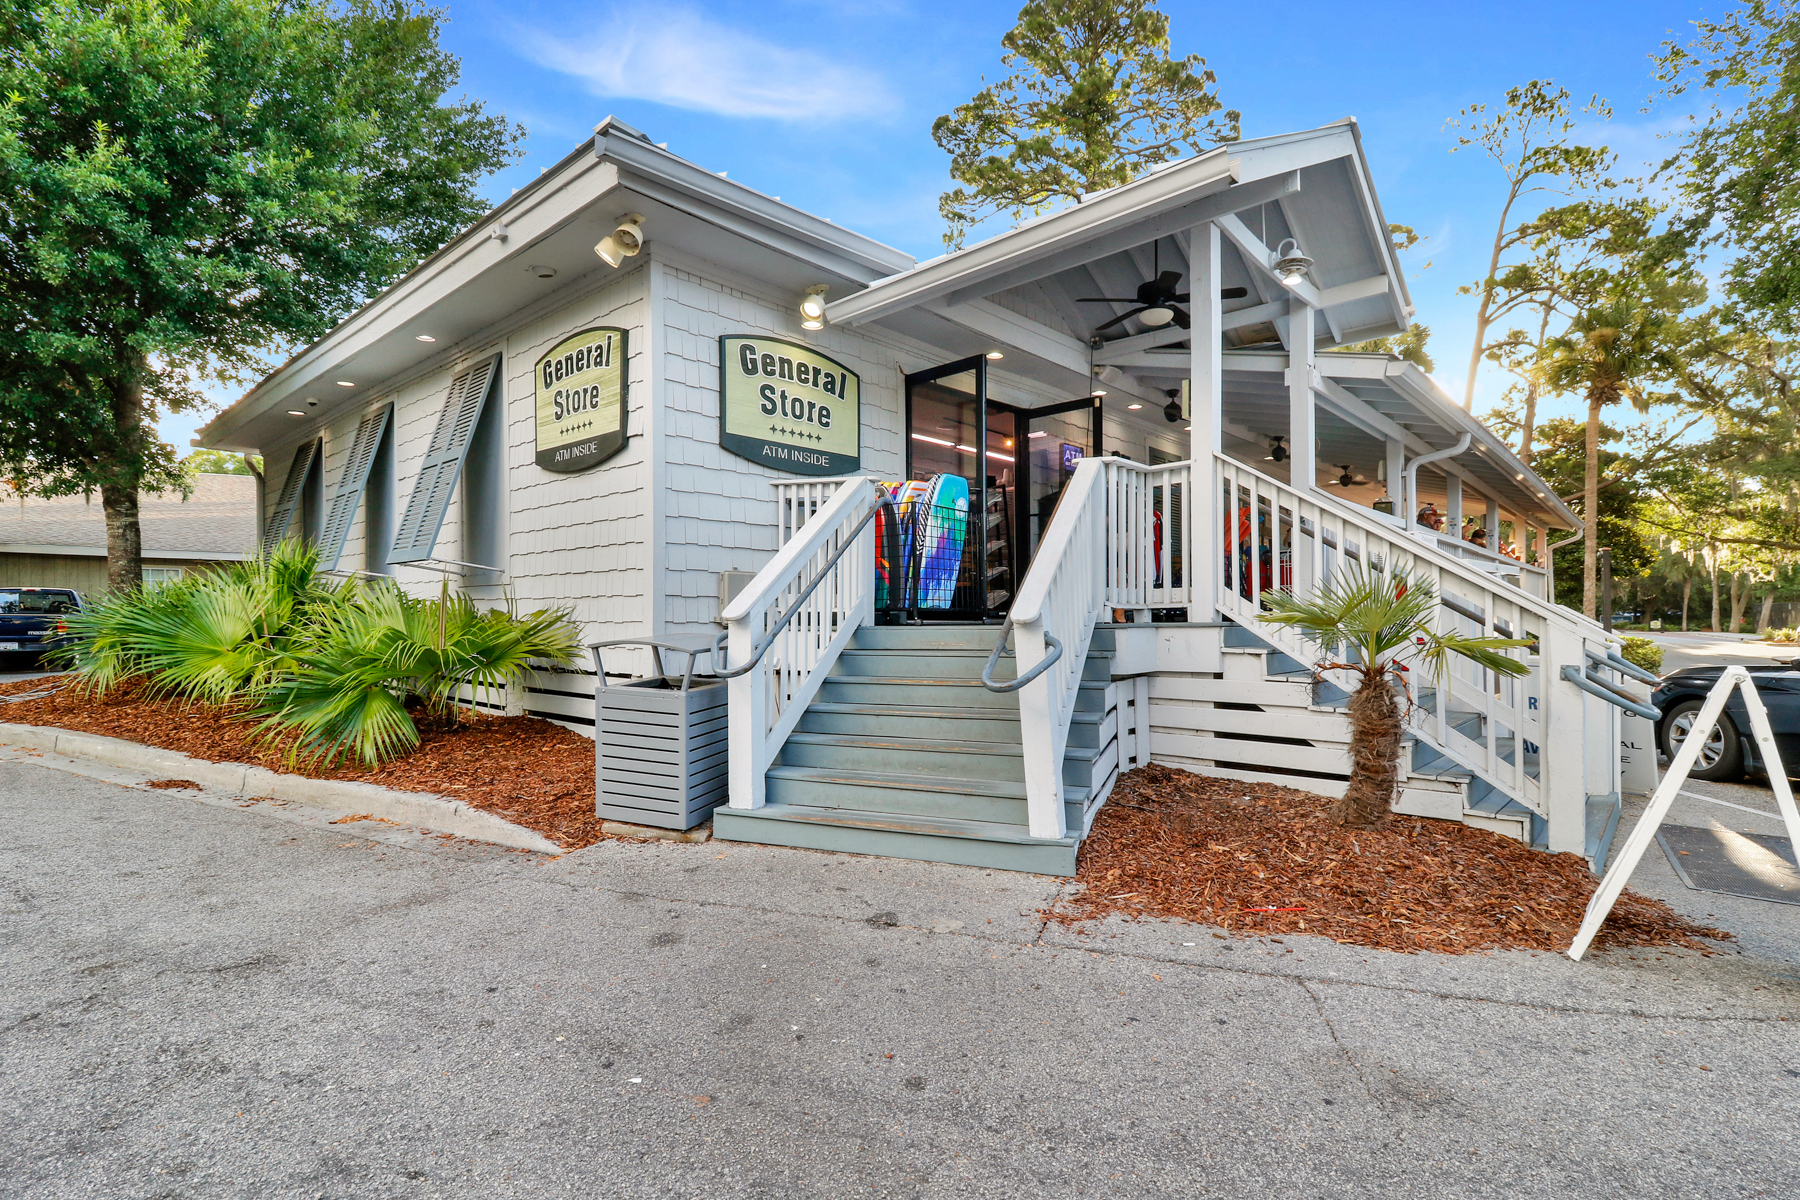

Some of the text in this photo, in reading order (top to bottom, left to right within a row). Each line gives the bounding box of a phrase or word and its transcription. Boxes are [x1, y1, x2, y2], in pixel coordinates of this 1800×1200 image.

[542, 334, 612, 390] General
[739, 342, 847, 402] General
[553, 384, 600, 422] Store
[758, 382, 832, 429] Store
[554, 441, 598, 463] ATM INSIDE
[762, 445, 830, 467] ATM INSIDE
